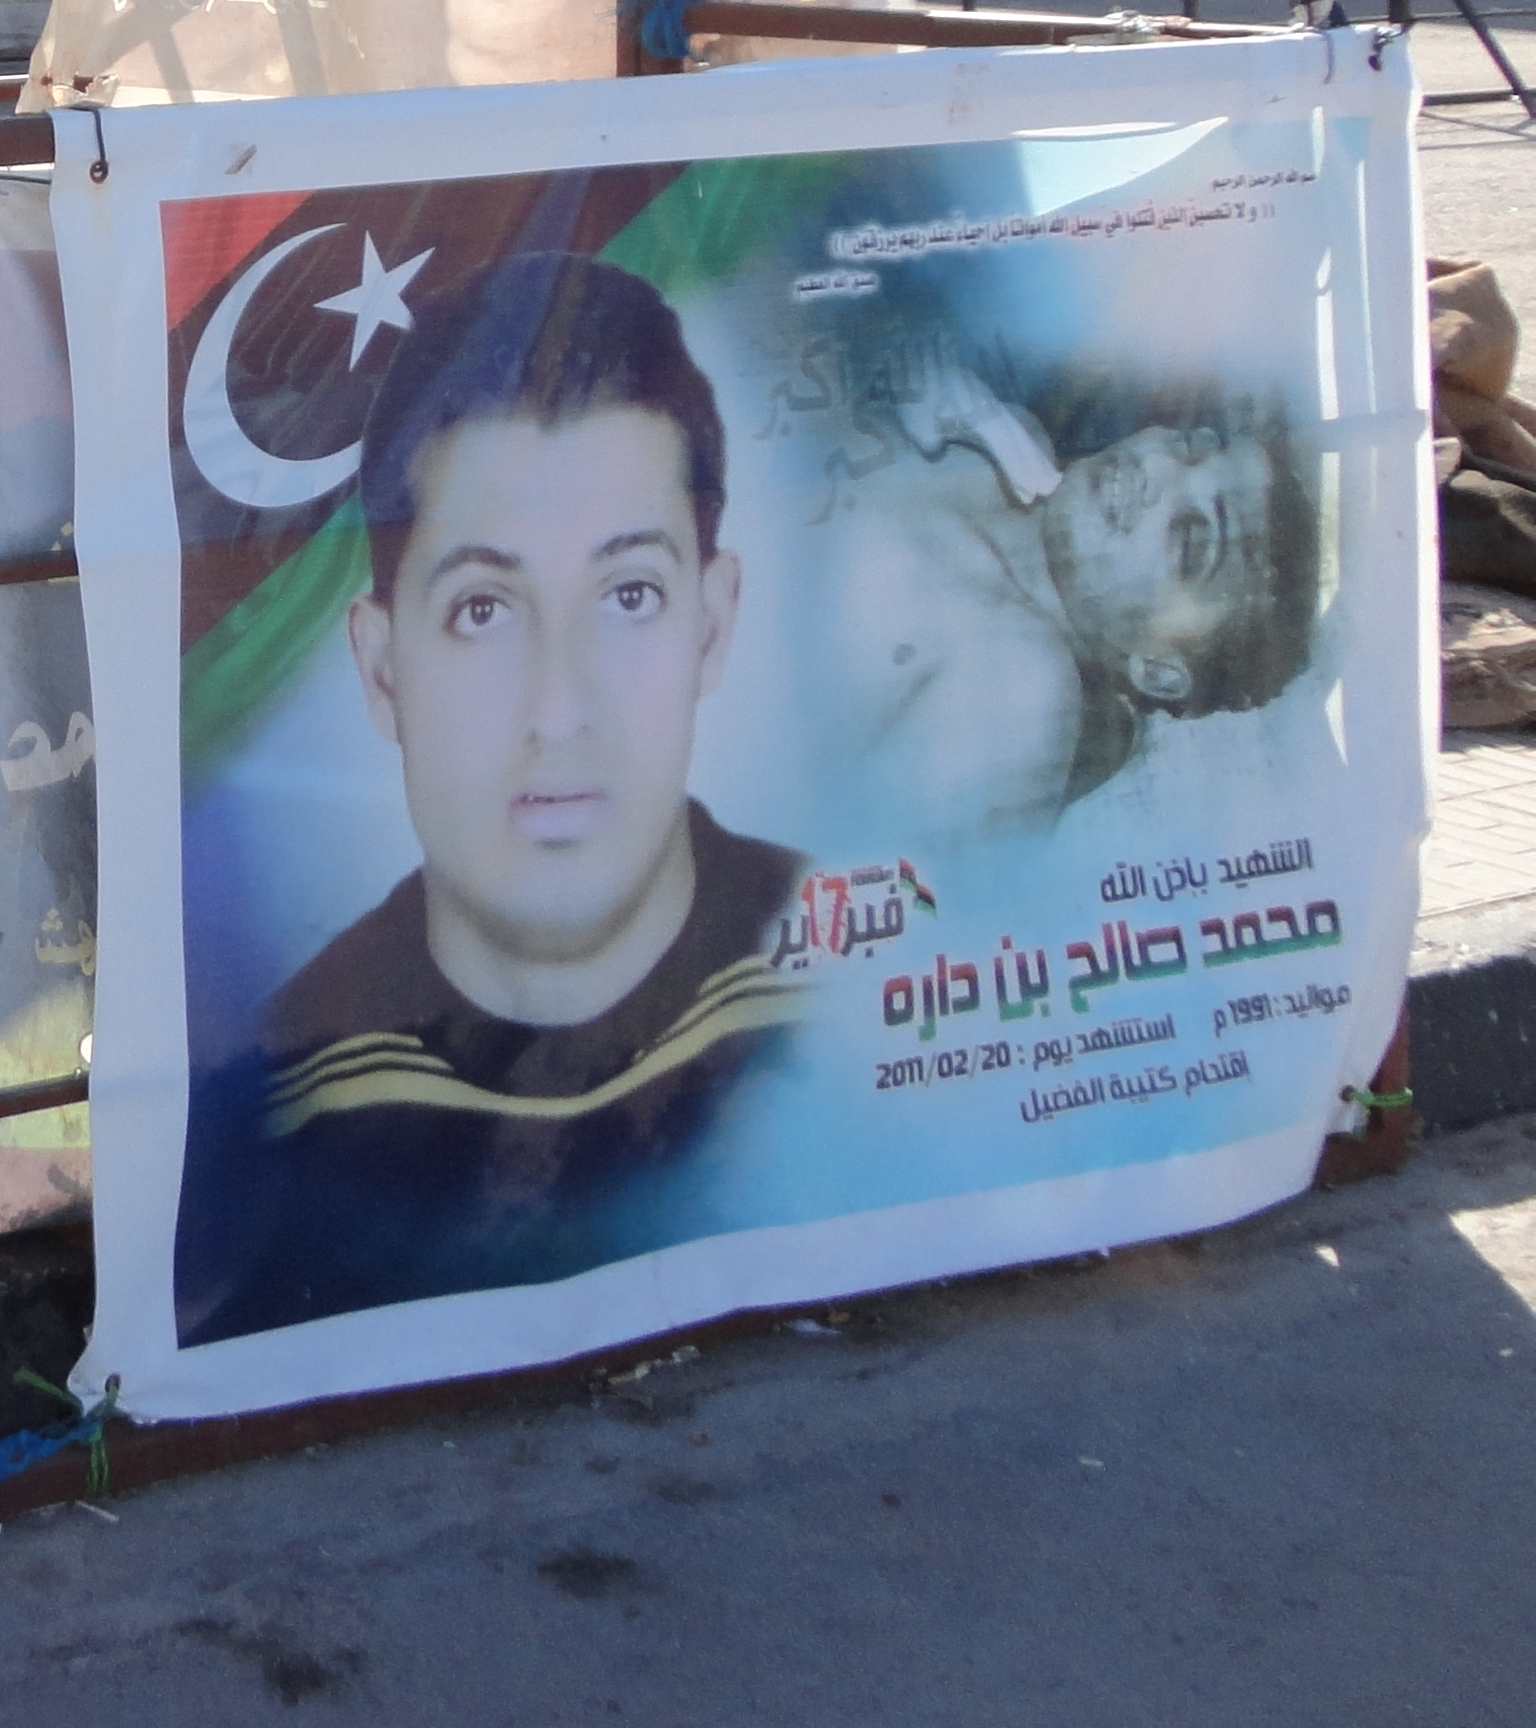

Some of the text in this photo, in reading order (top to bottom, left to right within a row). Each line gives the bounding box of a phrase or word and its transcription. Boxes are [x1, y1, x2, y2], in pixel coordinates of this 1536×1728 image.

[1100, 860, 1146, 905] الله
[1217, 837, 1313, 886] الشهيد
[881, 898, 1343, 1042] محمد صالح بن داره
[1032, 1039, 1074, 1071] يوم
[1077, 1014, 1176, 1057] استشهد
[1019, 1049, 1251, 1124] اقتحام كتيبة الفضيل
